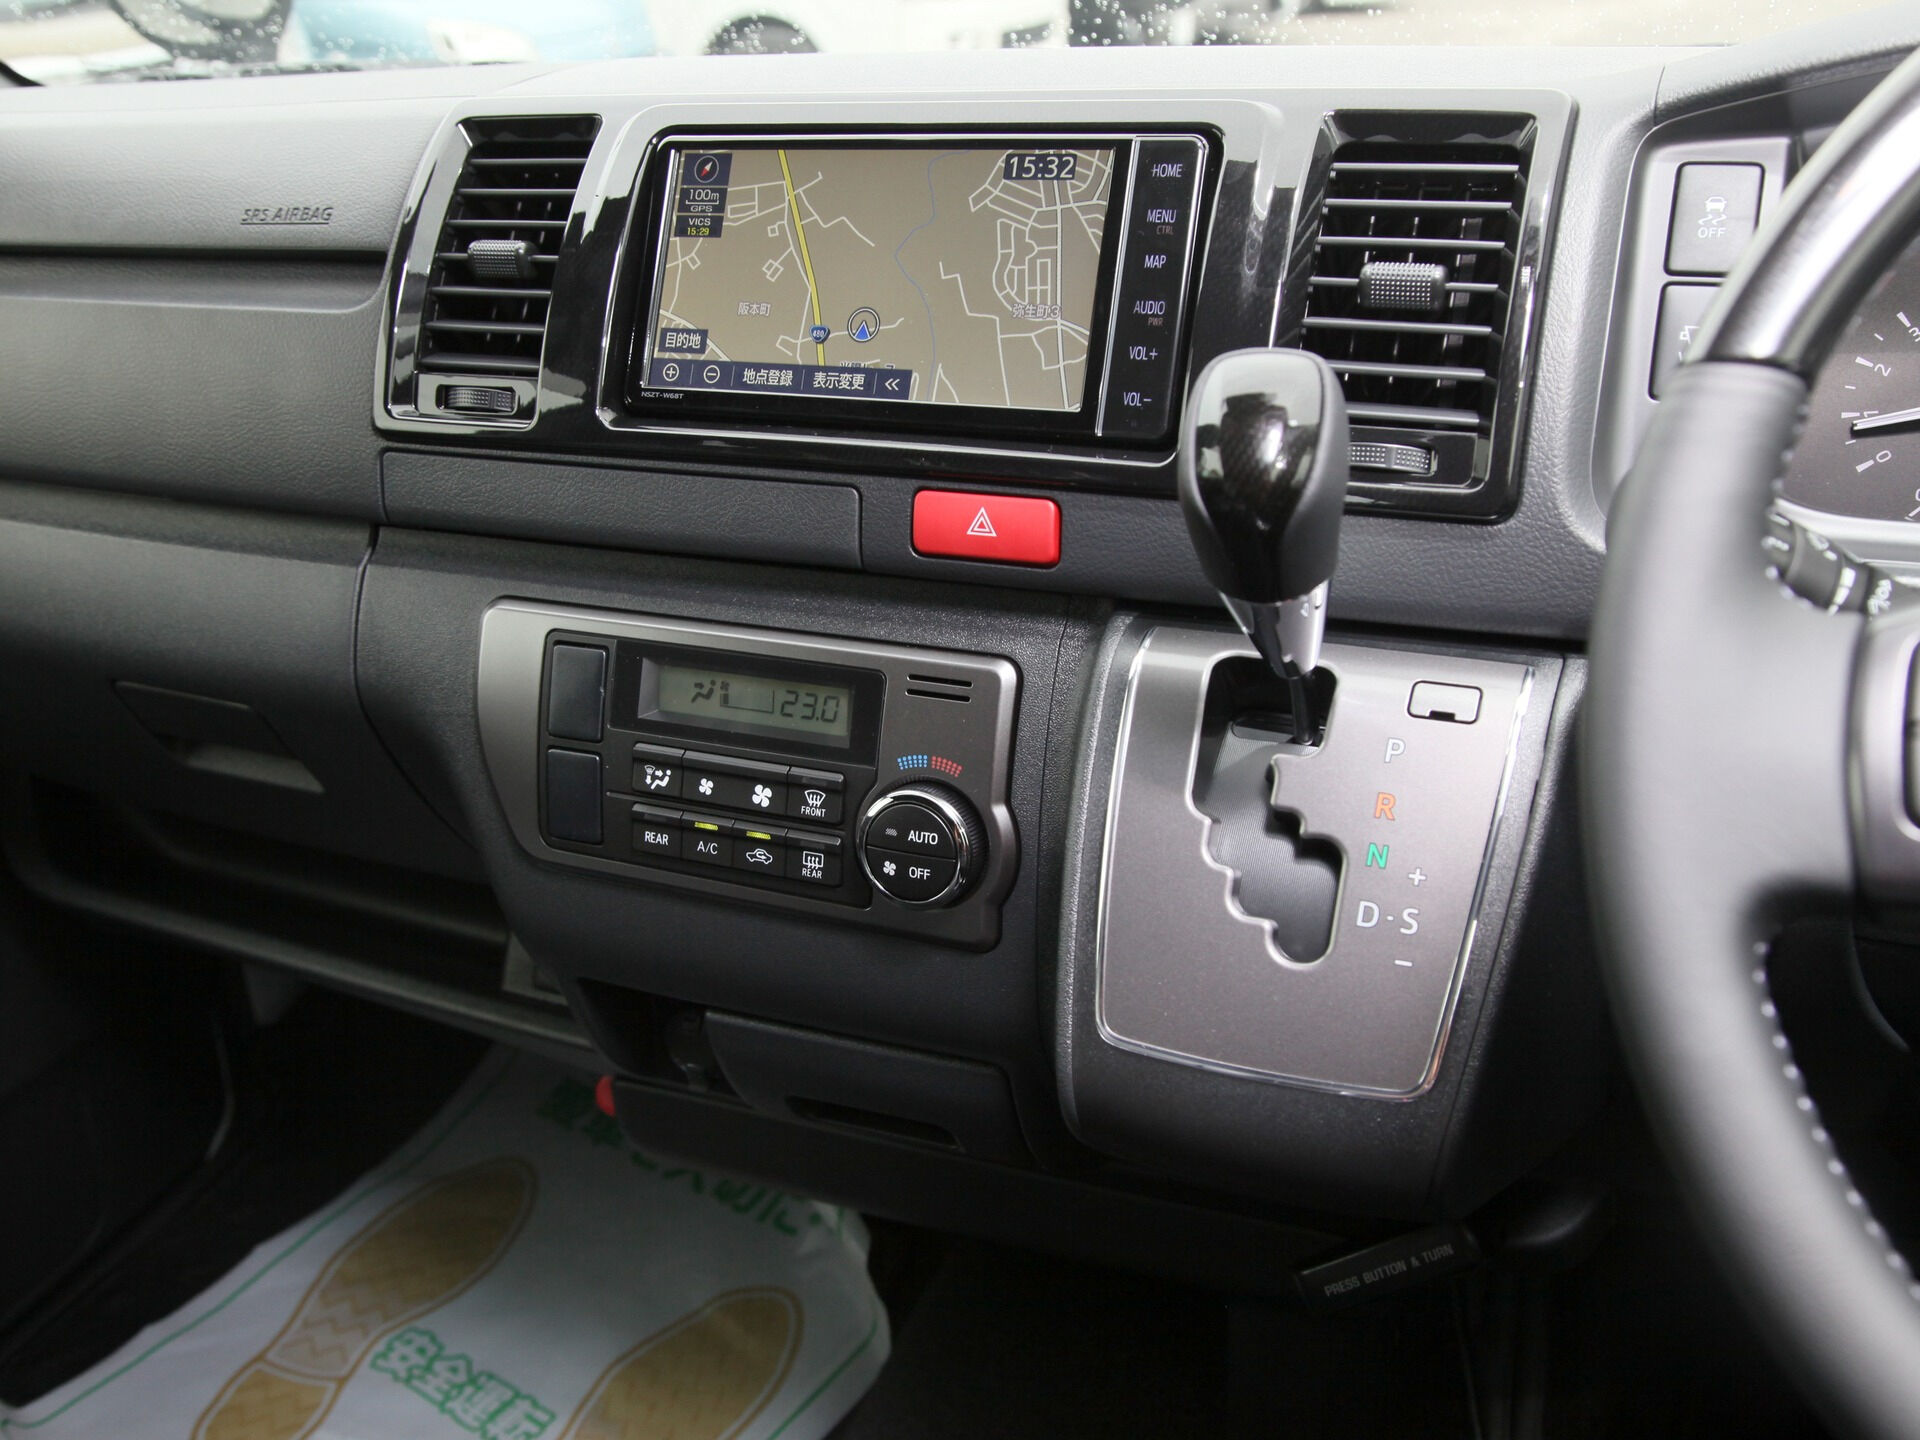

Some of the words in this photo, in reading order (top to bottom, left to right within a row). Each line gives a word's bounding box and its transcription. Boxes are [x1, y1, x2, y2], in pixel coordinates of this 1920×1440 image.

[1010, 156, 1075, 178] 15:32
[1152, 163, 1183, 178] HOME
[689, 189, 720, 200] 100m
[271, 207, 334, 221] AIRBAG
[1146, 209, 1177, 223] MENU
[688, 218, 711, 226] VICS
[687, 227, 710, 236] 15:29
[1156, 226, 1174, 235] CTRL
[1697, 227, 1726, 239] OFF
[1144, 254, 1167, 269] MAP
[737, 302, 771, 317] 阪本町
[1133, 300, 1166, 315] AUDIO
[1147, 317, 1164, 326] PWR
[665, 332, 702, 349] 目的地
[742, 367, 793, 387] 地点登録
[1874, 363, 1892, 377] 2
[813, 371, 866, 390] 表示変更
[640, 391, 685, 400] NSZT-W68T
[1876, 450, 1892, 464] 0
[780, 690, 841, 724] 23.0
[1384, 737, 1406, 763] P
[801, 805, 826, 818] FRONT
[1374, 791, 1397, 821] R
[644, 831, 669, 846] REAR
[908, 829, 938, 846] AUTO
[697, 840, 718, 855] A/C
[1365, 842, 1390, 869] N
[801, 866, 823, 880] REAR
[909, 866, 931, 881] OFF
[1324, 1275, 1361, 1297] PRESS
[1362, 1260, 1408, 1284] BUTTON
[1410, 1256, 1421, 1268] &
[1421, 1243, 1455, 1263] TURN
